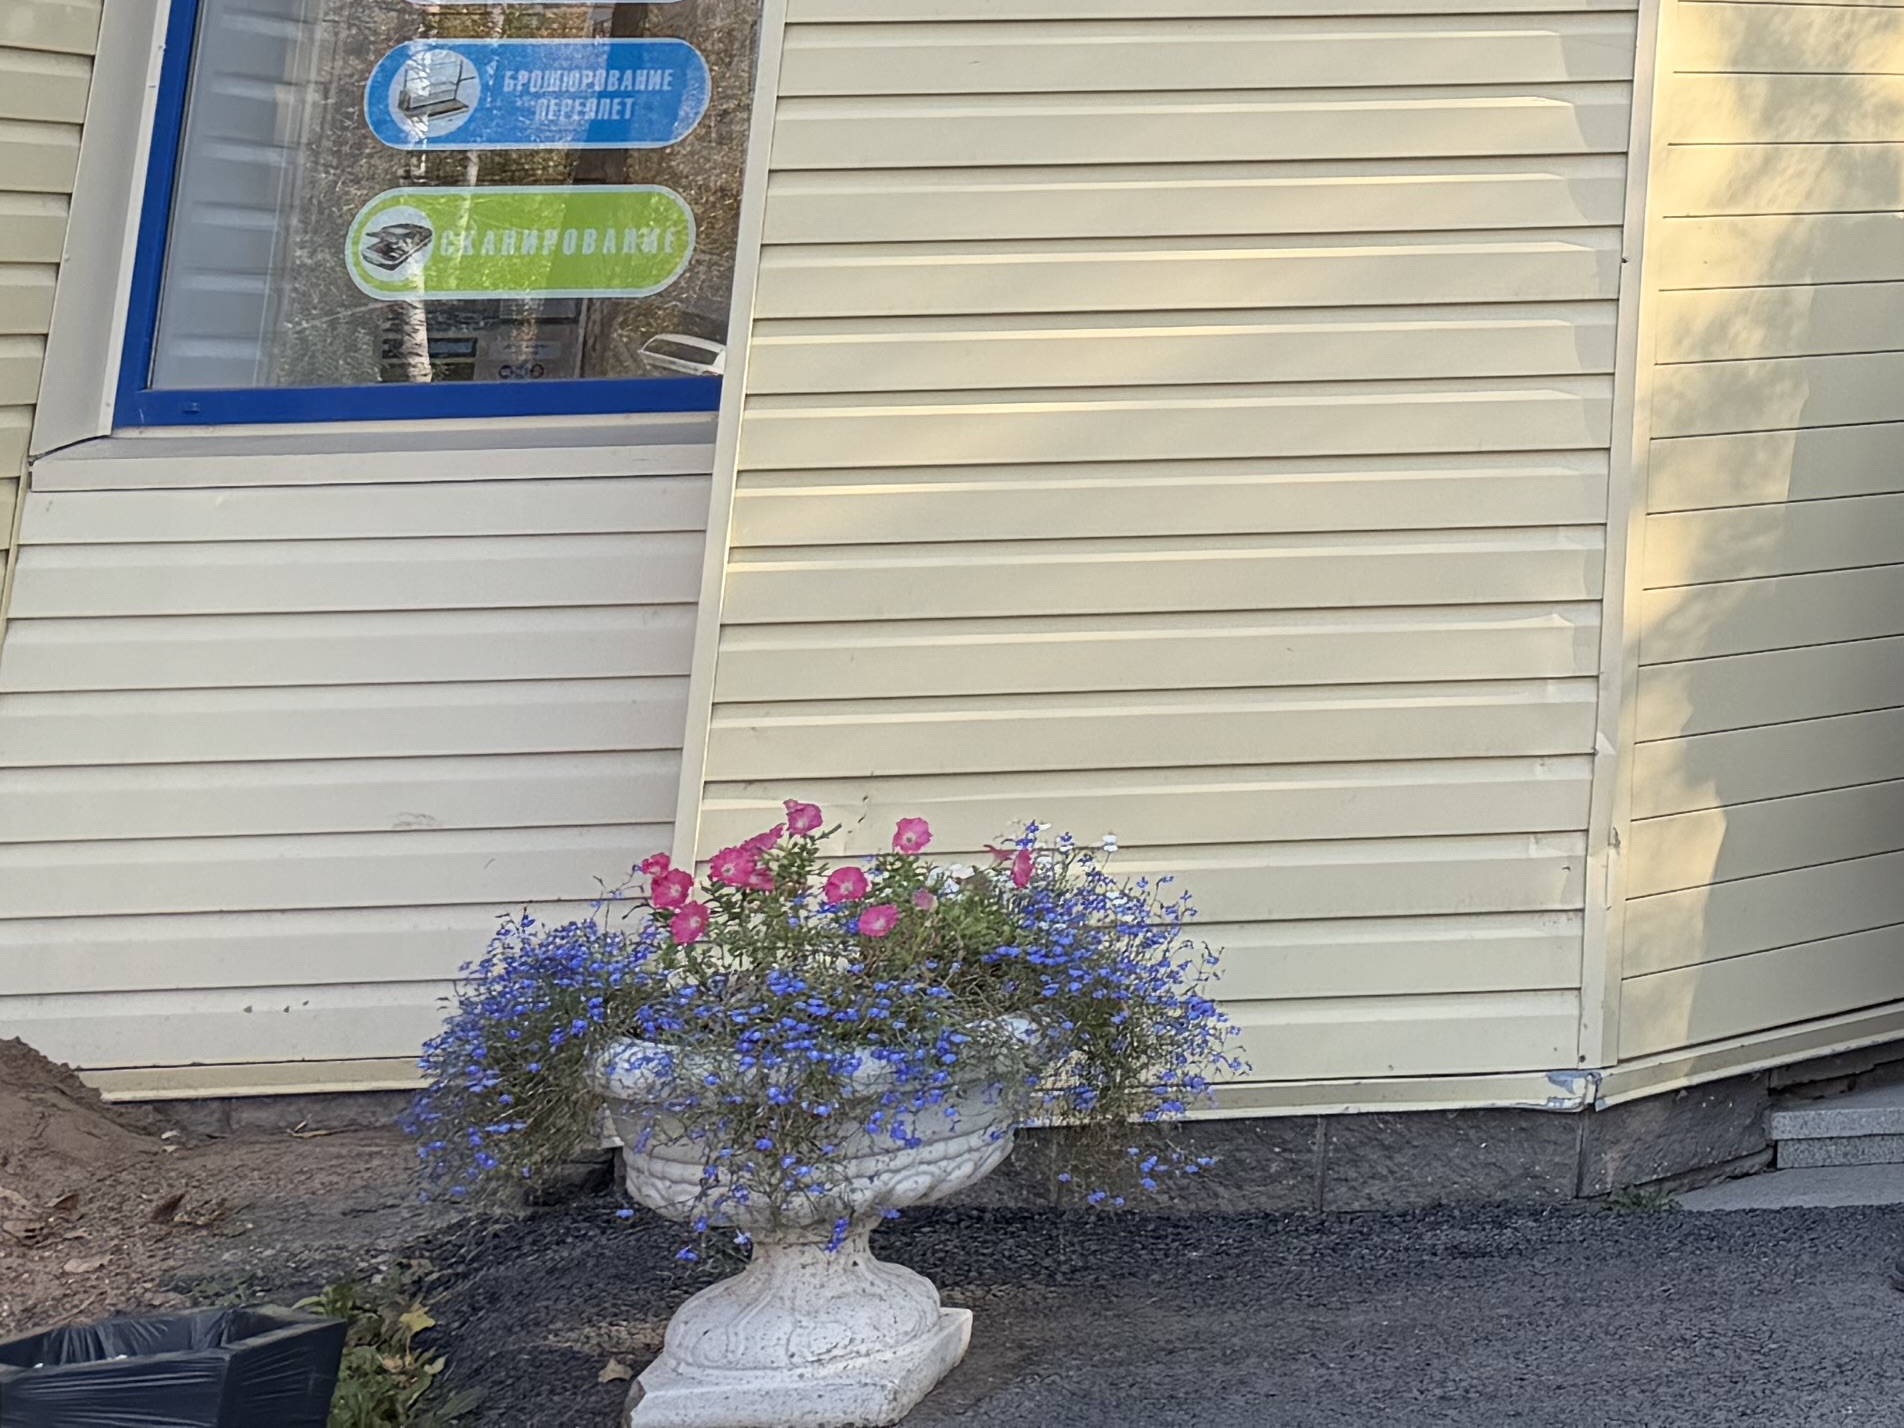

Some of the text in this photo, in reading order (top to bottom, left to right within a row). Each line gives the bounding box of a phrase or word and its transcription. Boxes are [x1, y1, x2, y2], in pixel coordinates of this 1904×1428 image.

[503, 69, 674, 92] БРОШЮРОВАНИЕ
[535, 98, 635, 120] ПЕРЕПЛЕТ
[440, 228, 674, 256] СКАНИРОВАНИЕ
